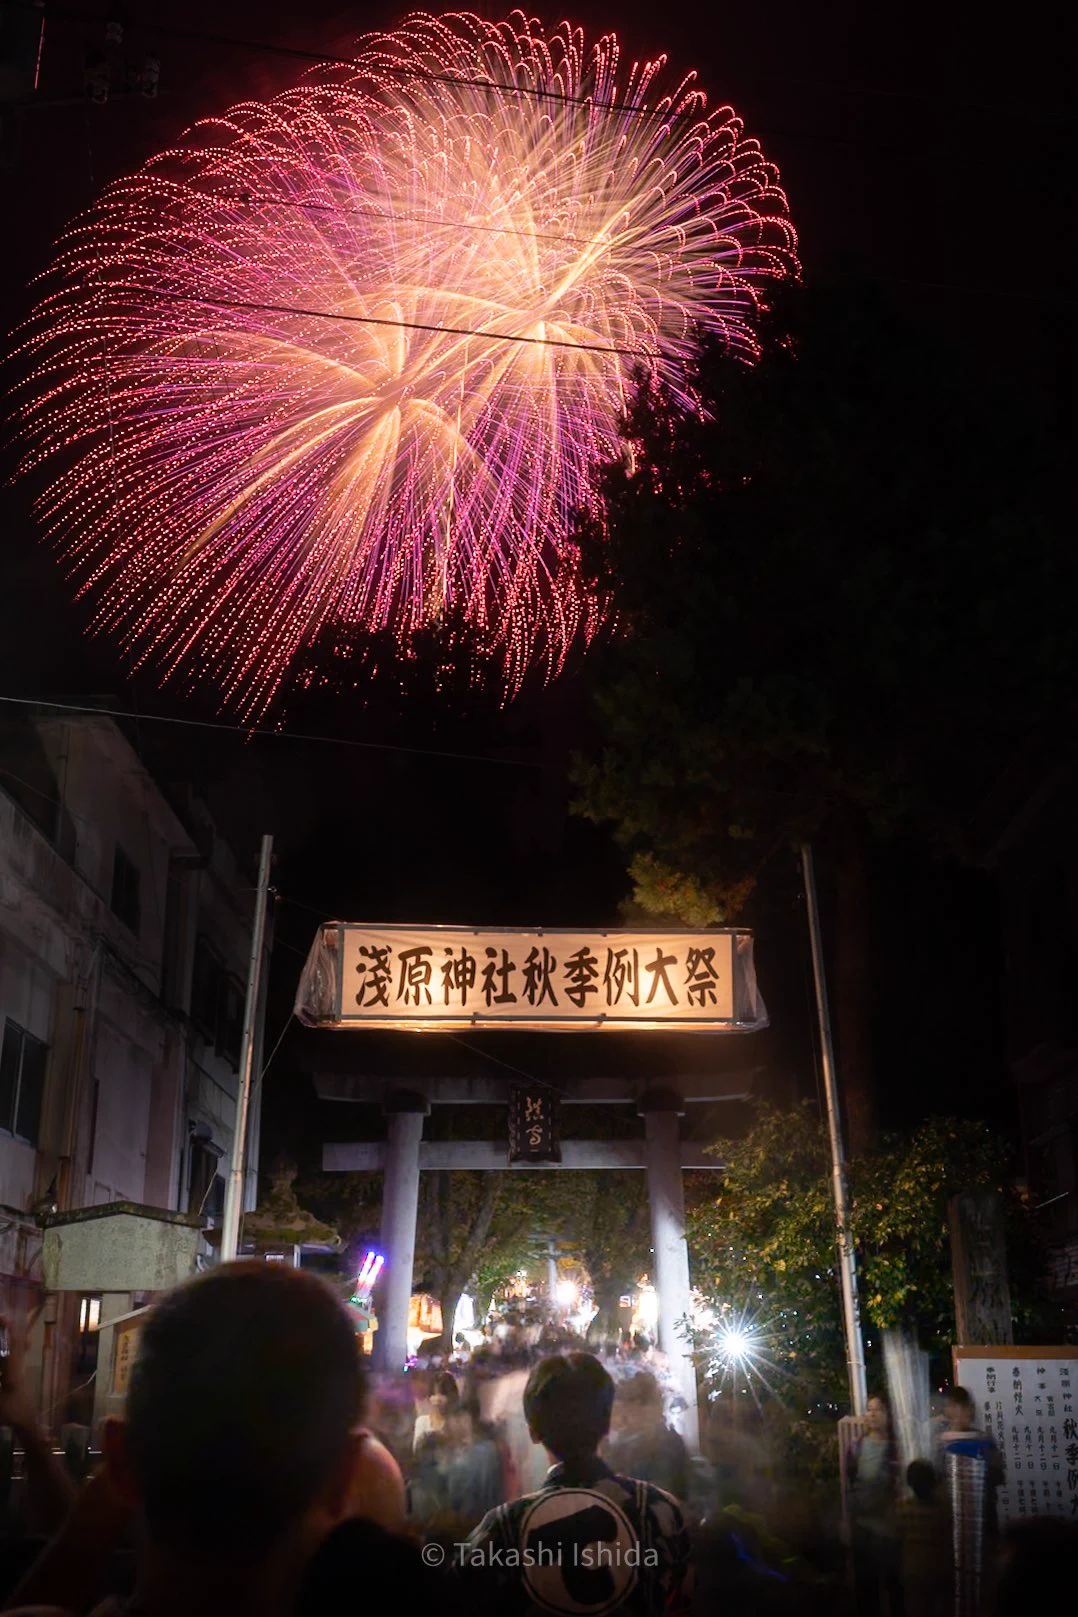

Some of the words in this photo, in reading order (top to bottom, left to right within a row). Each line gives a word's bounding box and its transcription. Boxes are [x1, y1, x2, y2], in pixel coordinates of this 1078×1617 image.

[356, 945, 719, 1008] 淺原神社秋季例大祭
